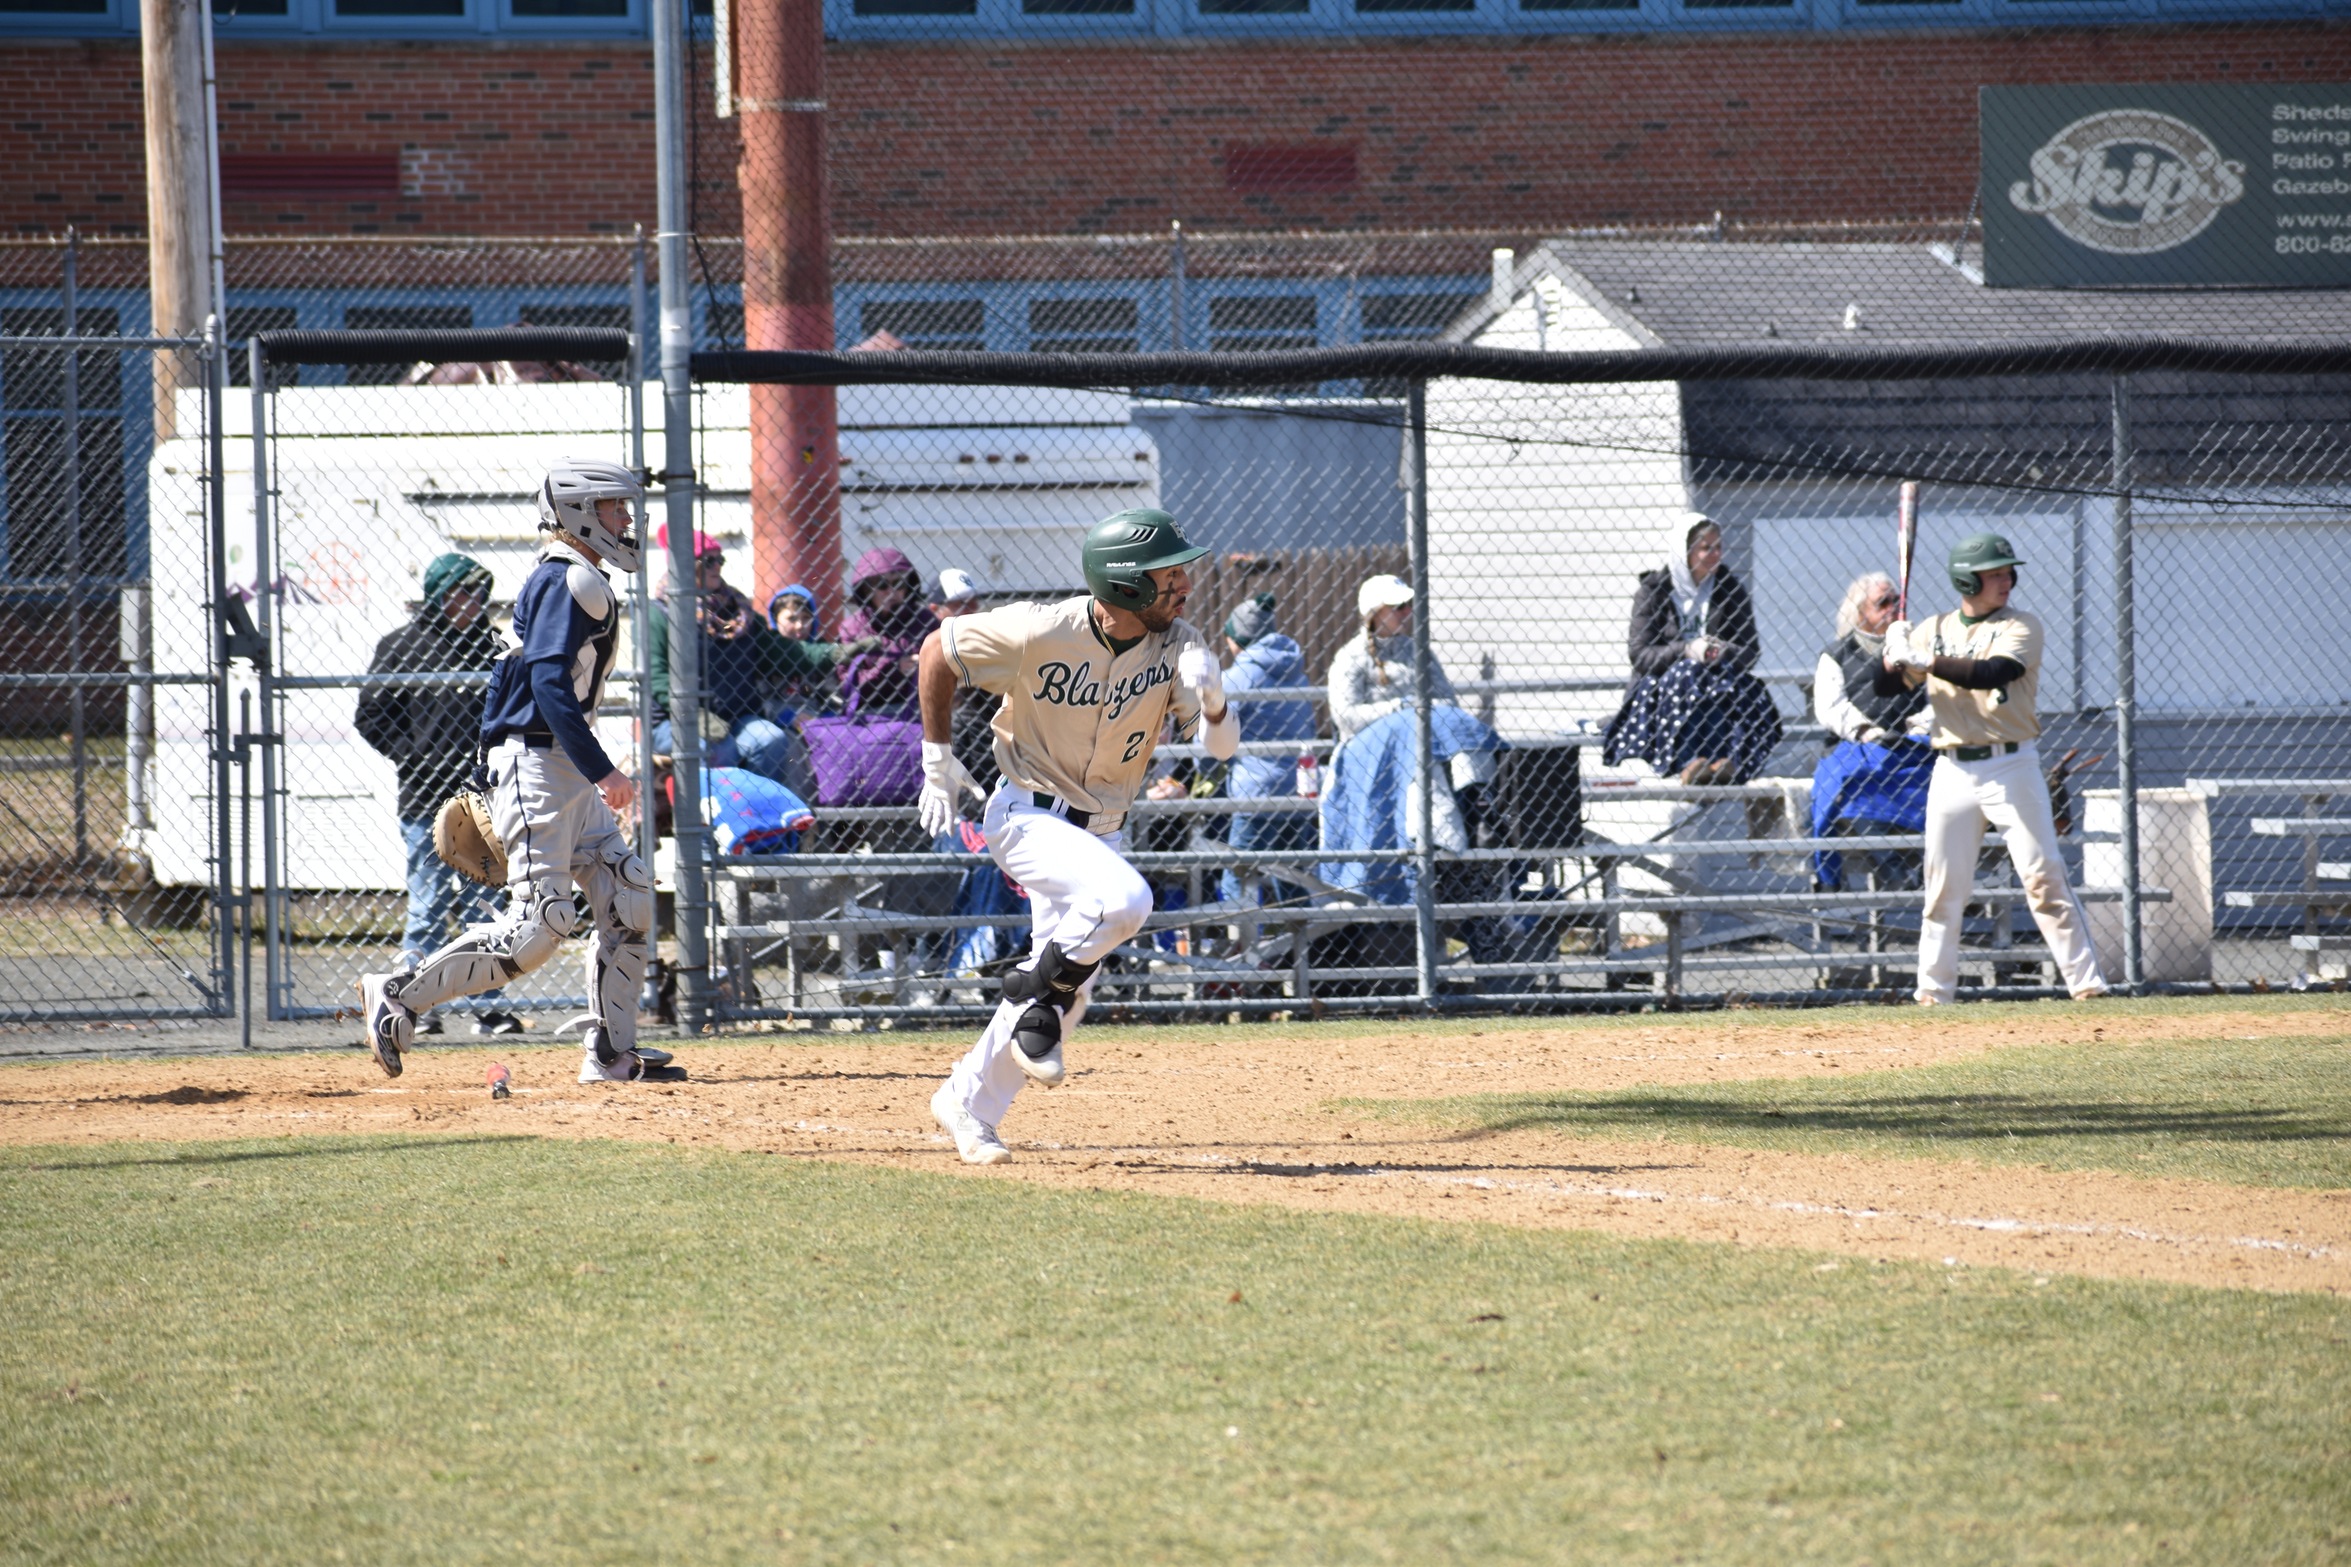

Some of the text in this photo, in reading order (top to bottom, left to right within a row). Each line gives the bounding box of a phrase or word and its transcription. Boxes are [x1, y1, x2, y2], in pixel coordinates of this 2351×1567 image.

[2272, 104, 2351, 120] Sheds
[2272, 127, 2350, 146] Swing
[2272, 152, 2334, 169] Patio
[2272, 178, 2351, 194] Gazeb
[1033, 657, 1175, 720] Blazers
[1120, 730, 1150, 764] 2
